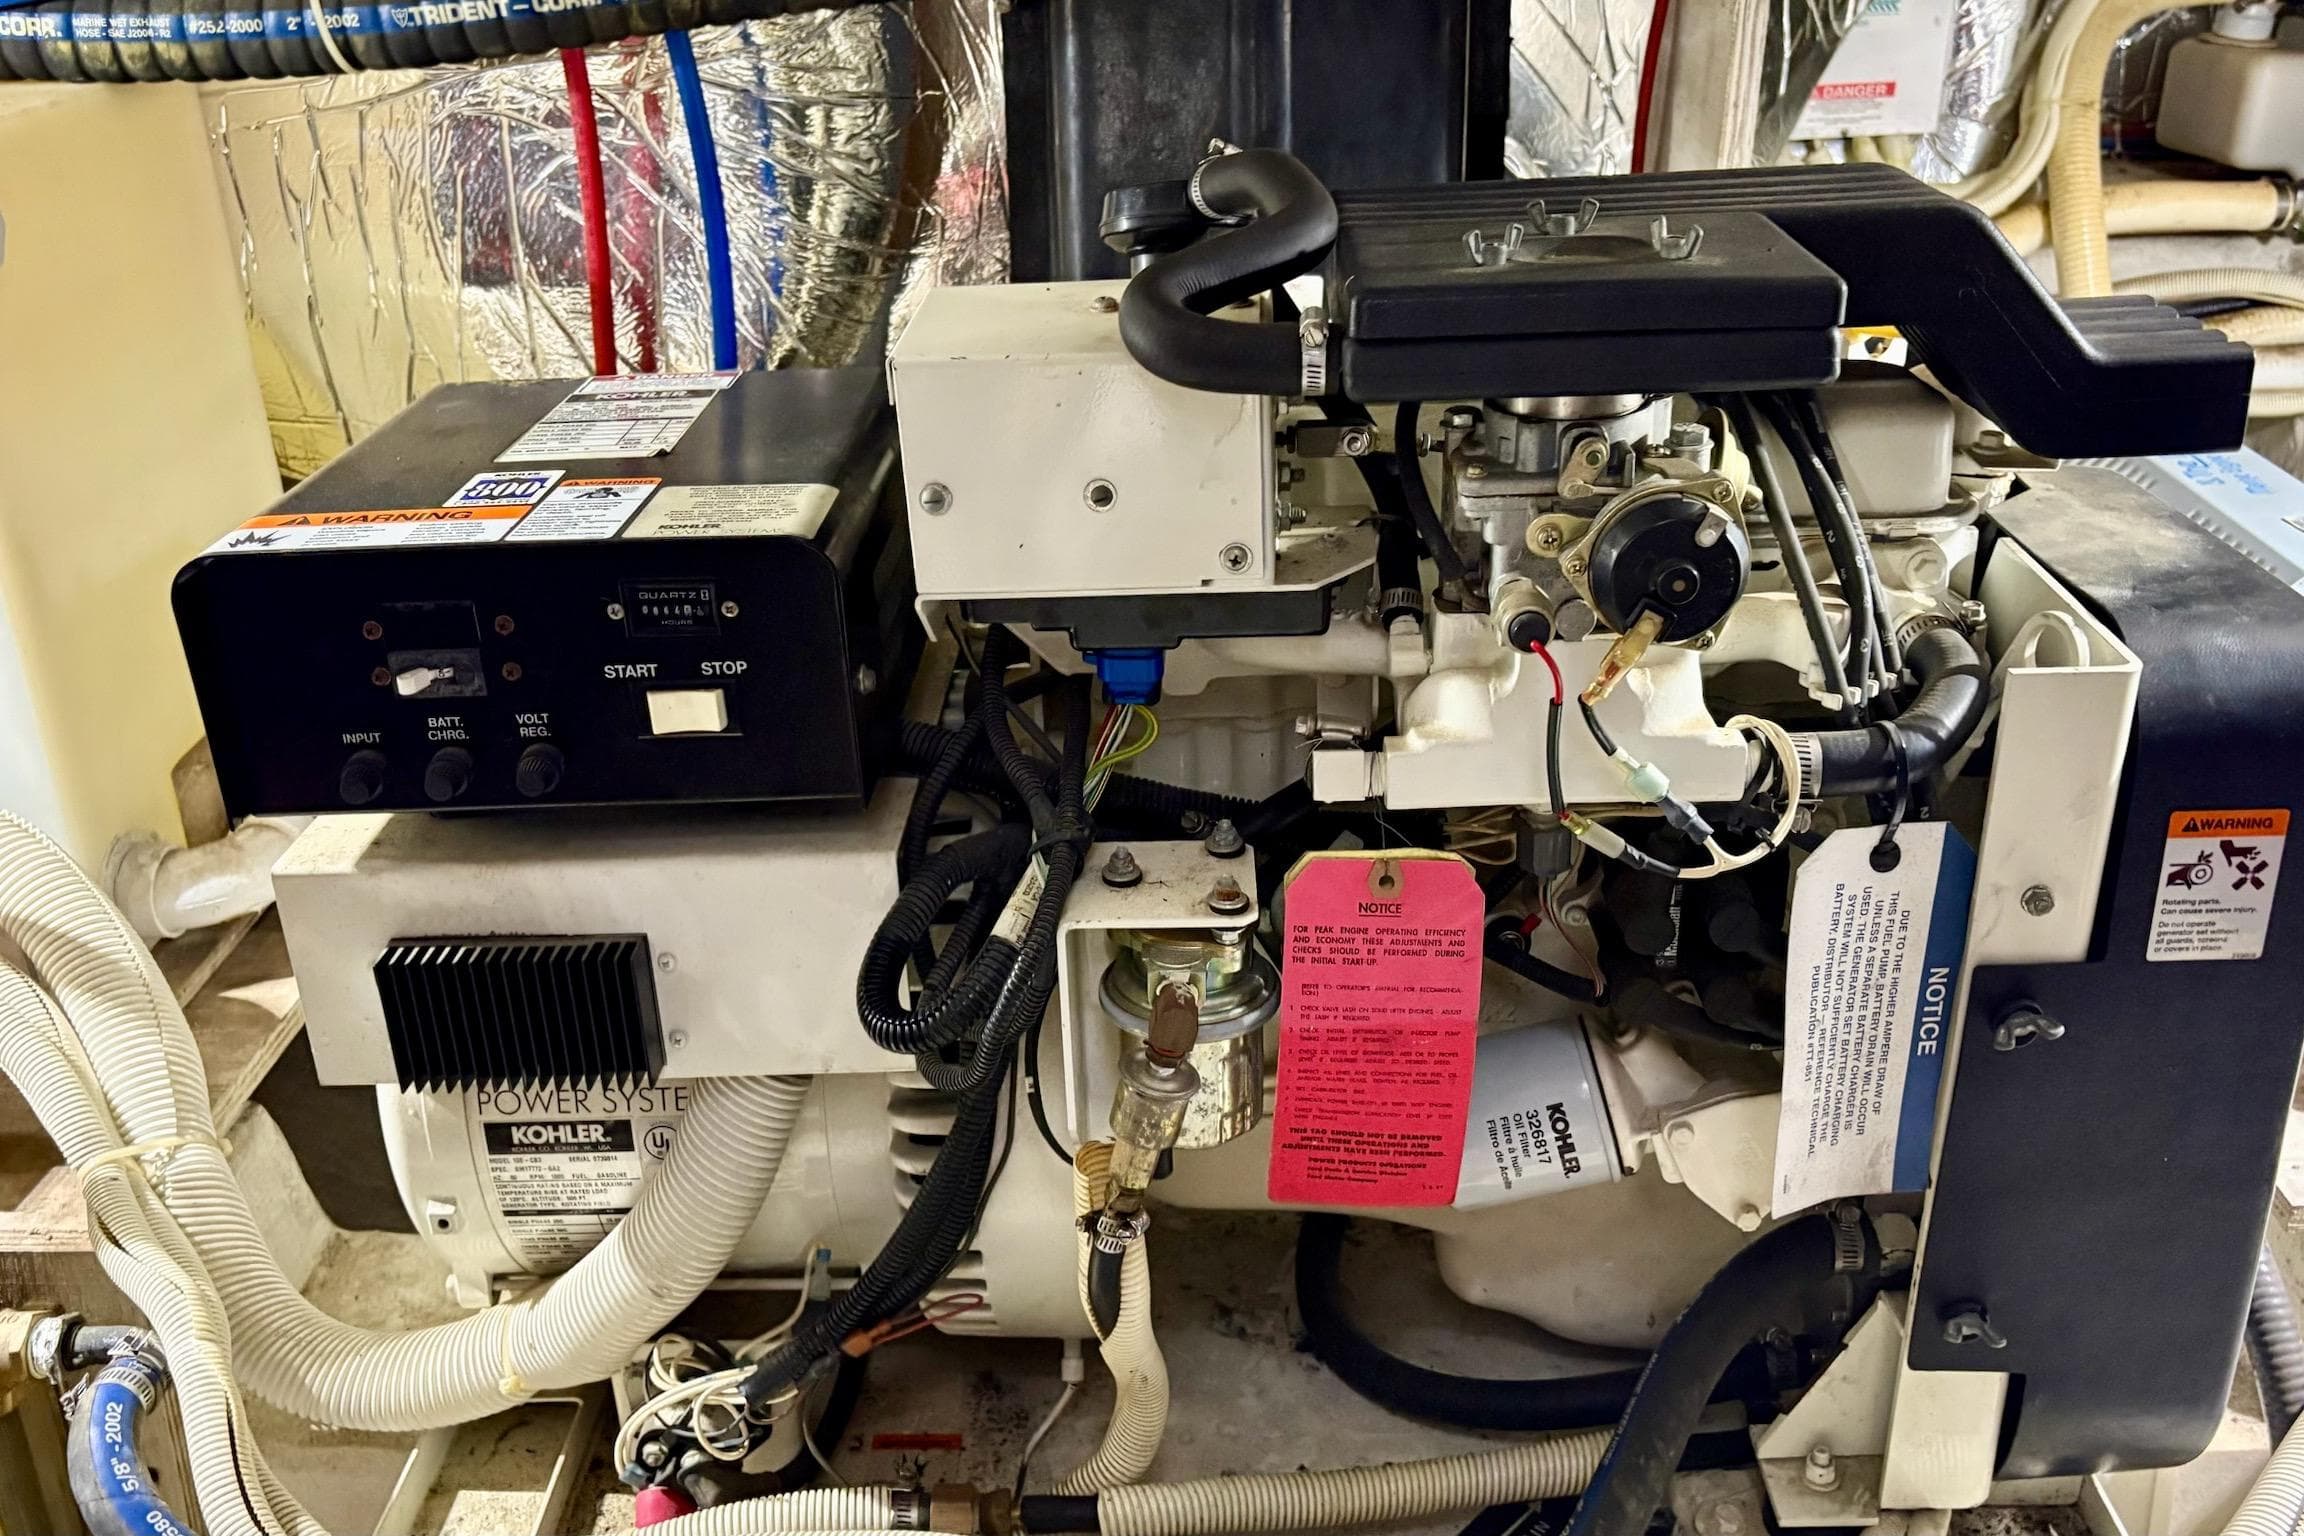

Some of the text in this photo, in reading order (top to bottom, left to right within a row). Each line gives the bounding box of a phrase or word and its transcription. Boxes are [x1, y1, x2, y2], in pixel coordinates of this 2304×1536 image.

[72, 18, 170, 28] MARINE WET EXHAUST
[75, 29, 100, 37] HOSE
[108, 29, 126, 38] SAE
[1822, 85, 1887, 99] DANGER
[467, 482, 541, 497] 800
[322, 511, 474, 525] WARNING
[604, 664, 658, 678] START
[701, 661, 748, 675] STOP
[428, 717, 464, 727] BATT.
[515, 713, 549, 724] VOLT
[342, 732, 381, 744] INPUT
[428, 730, 470, 741] CHRG.
[520, 727, 552, 737] REG.
[2200, 817, 2273, 830] WARNING
[1358, 902, 1402, 914] NOTICE
[1888, 891, 1900, 916] THIS
[1315, 926, 1333, 934] PEAK
[1341, 927, 1368, 935] ENGINE
[1375, 927, 1416, 936] OPERATING
[1425, 929, 1466, 937] EFFICIENCY
[1856, 921, 1867, 943] THE
[1869, 900, 1884, 943] UNLESS
[1883, 919, 1895, 946] FUEL
[1292, 946, 1321, 954] CHECKS
[1329, 947, 1360, 955] SHOULD
[1383, 948, 1428, 957] PERFORMED
[1434, 950, 1464, 958] DURING
[1293, 936, 1465, 947] AND ECONOMY THESE ADJUSTMENTS AND
[1292, 956, 1305, 964] THE
[1310, 957, 1341, 965] INITIAL
[1823, 938, 1837, 1011] DISTRIBUTOR
[1847, 946, 1863, 1012] GENERATOR
[1860, 956, 1875, 1011] SEPARATE
[1808, 965, 1820, 1040] PUBLICATION
[1871, 984, 1885, 1032] BATTERY
[1873, 910, 1910, 1114] DUE TO THE HIGHER AMPERE DRAW OF
[1916, 968, 1950, 1057] NOTICE
[1820, 894, 1857, 1142] SYSTEM WILL NOT SUFFICIENTLY CHARGE THE
[1844, 1015, 1853, 1036] SET
[1854, 1015, 1866, 1062] BATTERY
[1866, 1034, 1878, 1068] DRAIN
[1814, 1028, 1826, 1092] REFERENCE
[1838, 1039, 1851, 1086] BATTERY
[1846, 1065, 1860, 1117] CHARGER
[1862, 1070, 1873, 1096] WILL
[478, 1090, 591, 1116] POWER
[1808, 1097, 1822, 1154] TECHNICAL
[1830, 1090, 1844, 1146] CHARGING
[1844, 1120, 1853, 1129] IS
[1856, 1098, 1868, 1135] OCCUR
[1289, 1127, 1307, 1135] THIS
[1309, 1128, 1327, 1136] TAG
[1329, 1129, 1365, 1137] SHOULD
[1400, 1133, 1442, 1141] REMOVED
[1353, 1139, 1408, 1148] OPERATIONS
[1487, 1120, 1499, 1148] Filtro
[1495, 1151, 1504, 1163] de
[1513, 1113, 1531, 1158] Oil Filter
[1526, 1110, 1552, 1164] 326817
[1281, 1143, 1340, 1152] ADJUSTMENTS
[1343, 1146, 1366, 1154] HAVE
[1369, 1147, 1390, 1155] BEEN
[1500, 1116, 1512, 1145] Filtre
[1511, 1154, 1522, 1178] huile
[1308, 1157, 1426, 1169] POWER PRODUCTS OPERATIONS
[110, 1457, 139, 1492] 5/8"
